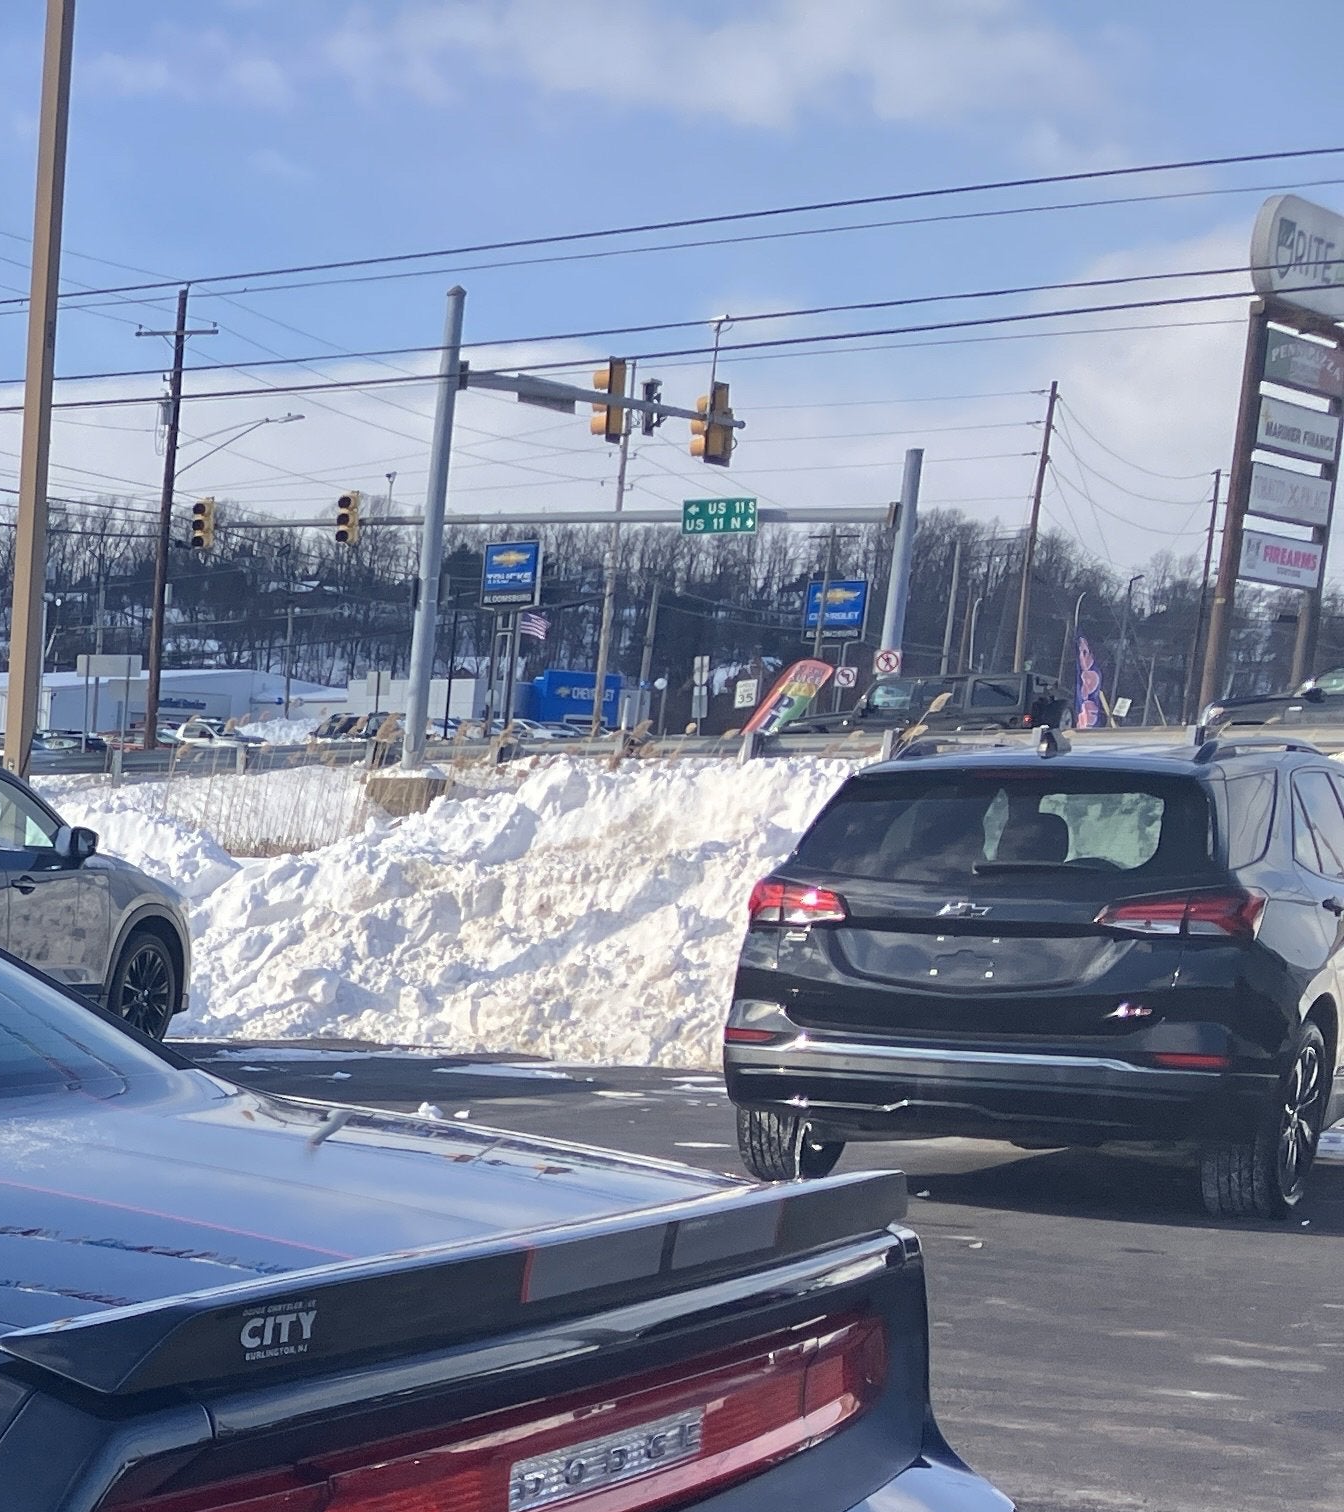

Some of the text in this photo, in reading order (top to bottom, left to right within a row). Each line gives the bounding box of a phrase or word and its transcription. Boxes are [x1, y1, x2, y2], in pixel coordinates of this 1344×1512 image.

[1295, 230, 1335, 284] RITE
[708, 501, 755, 515] US 11 S
[686, 517, 741, 531] US 11 N
[1263, 544, 1318, 571] FIREARMS
[738, 693, 754, 704] 35
[240, 1310, 317, 1349] CITY
[514, 1421, 701, 1501] DODGE
